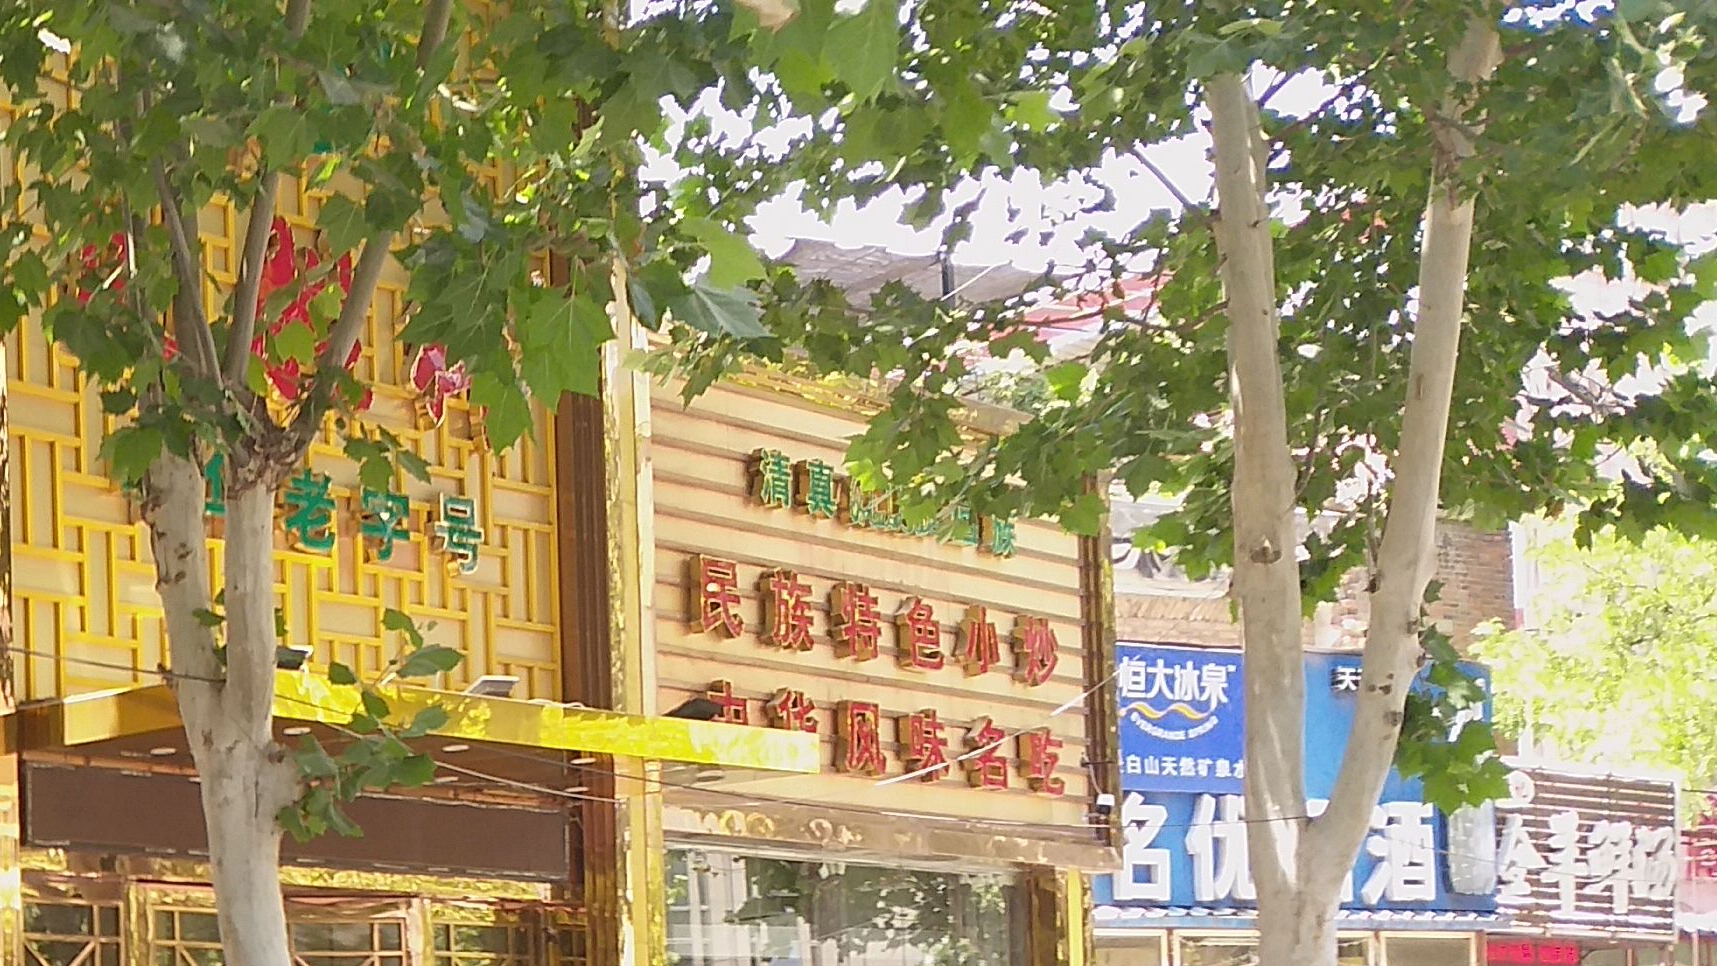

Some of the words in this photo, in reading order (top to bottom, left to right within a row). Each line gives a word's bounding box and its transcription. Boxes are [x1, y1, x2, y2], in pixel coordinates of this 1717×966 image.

[696, 555, 1059, 687] 民族特色小炒
[1119, 655, 1229, 705] 恒大冰泉
[1118, 751, 1244, 779] 白山天然矿泉水
[1113, 792, 1436, 905] 名优酒
